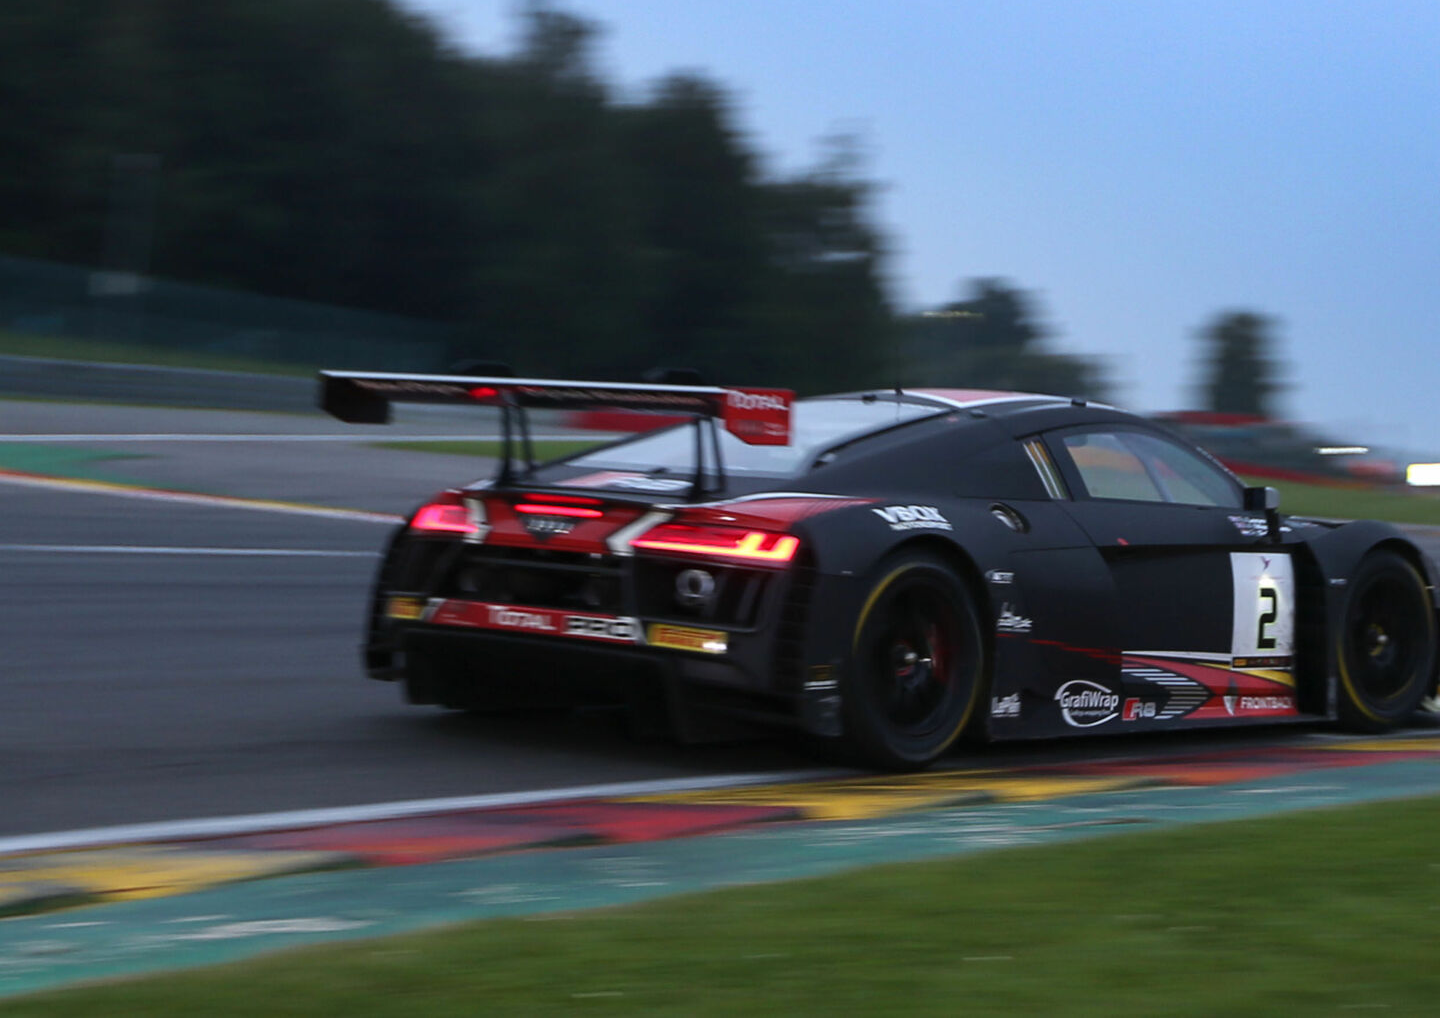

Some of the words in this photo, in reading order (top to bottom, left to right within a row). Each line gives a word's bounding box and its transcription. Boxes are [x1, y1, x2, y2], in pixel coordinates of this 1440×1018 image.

[726, 390, 789, 411] TOTAL
[871, 505, 948, 523] VBOX
[486, 604, 557, 631] TOTAL
[1257, 587, 1277, 649] 2
[1060, 691, 1119, 711] GrafiWrap
